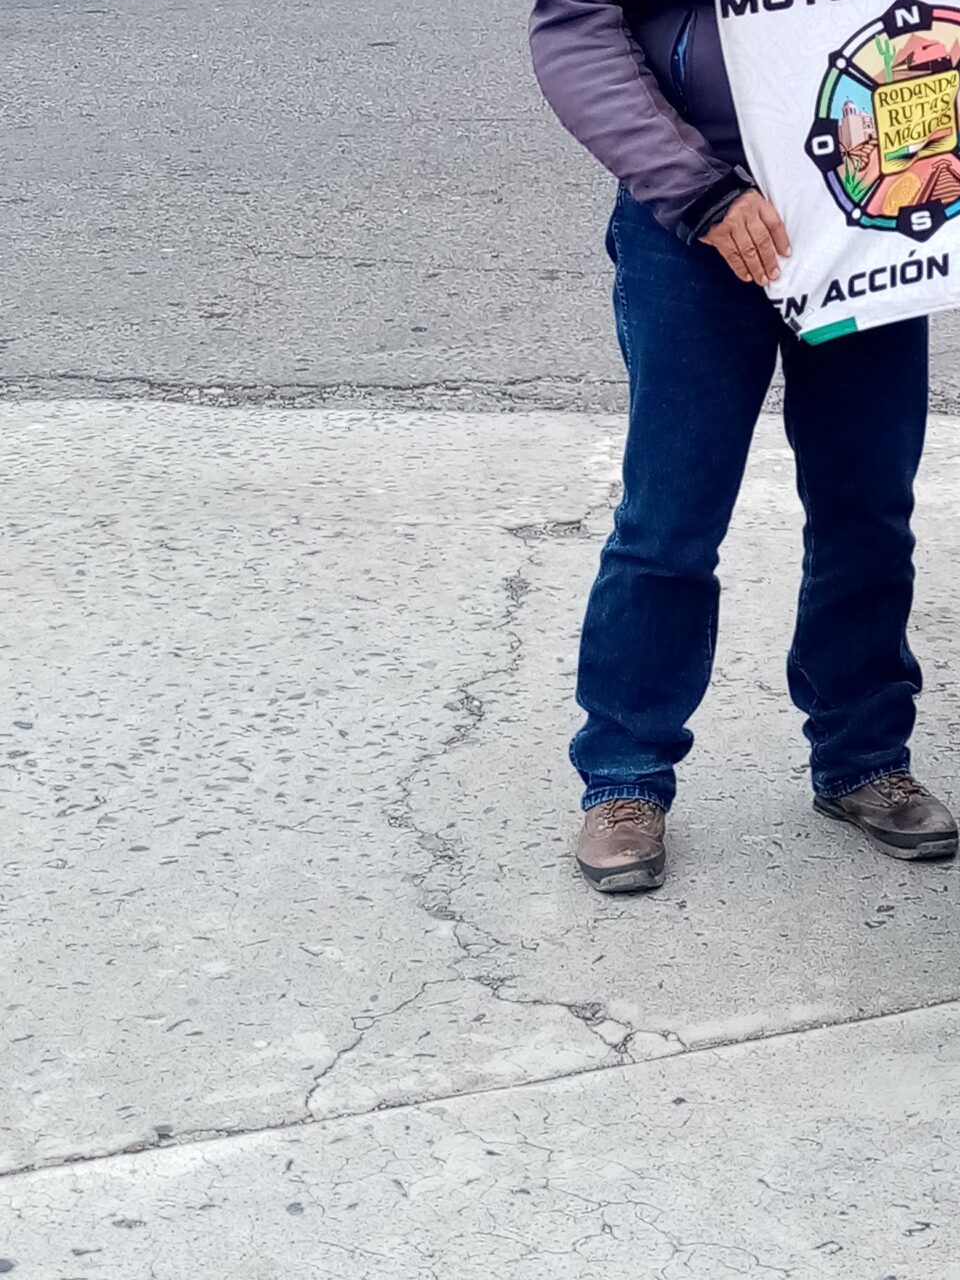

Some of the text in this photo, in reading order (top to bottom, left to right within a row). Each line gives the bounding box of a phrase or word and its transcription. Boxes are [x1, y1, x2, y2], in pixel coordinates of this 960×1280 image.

[895, 5, 920, 28] N
[811, 134, 834, 156] O
[910, 209, 933, 231] S
[820, 249, 949, 308] ACCIÓN
